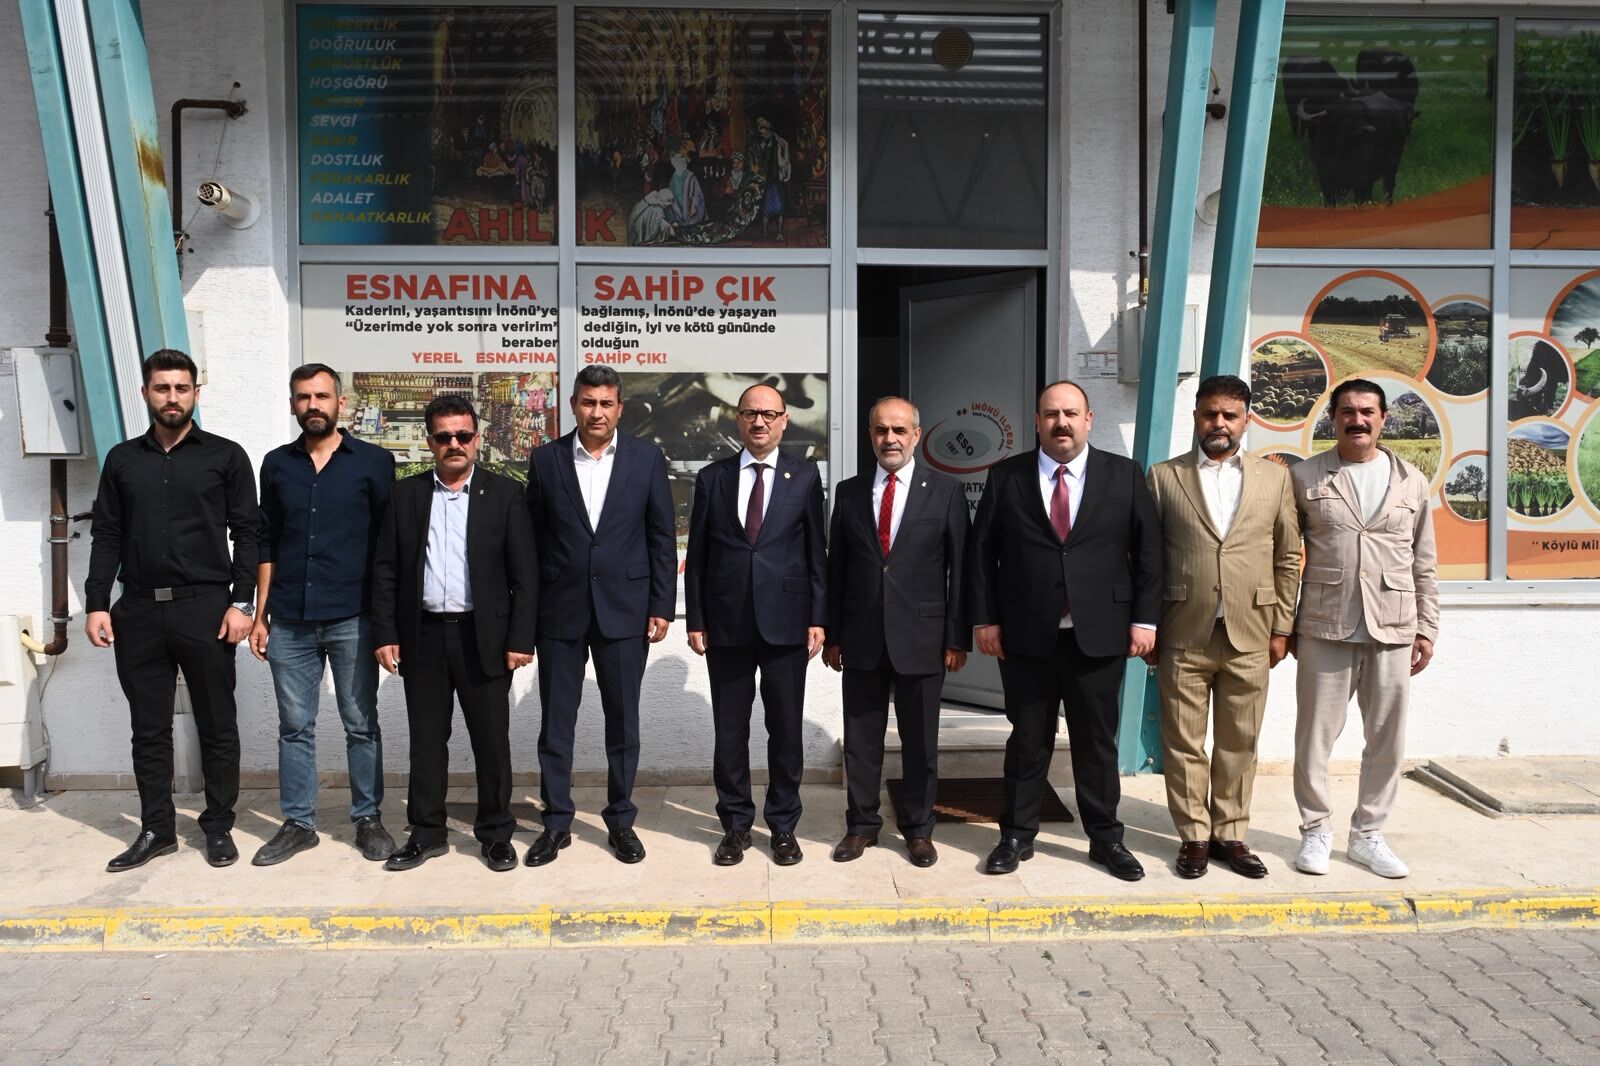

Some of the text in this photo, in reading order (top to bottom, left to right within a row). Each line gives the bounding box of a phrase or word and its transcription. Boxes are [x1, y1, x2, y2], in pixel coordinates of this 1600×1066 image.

[308, 17, 400, 32] RTLİK
[309, 36, 397, 50] DOĞRULUK
[308, 55, 402, 70] ÜTLÜK
[309, 75, 388, 91] HOŞGÖRÜ
[310, 113, 357, 128] SEVGİ
[310, 154, 384, 166] DOSTLUK
[311, 192, 374, 205] ADALET
[346, 270, 777, 306] ESNAFINA SAHİP ÇIK
[345, 304, 410, 318] Kaderini,
[415, 305, 492, 318] yaşantısını
[581, 305, 650, 319] bağlamış,
[719, 308, 777, 319] yaşayan
[427, 321, 453, 334] yok
[458, 323, 497, 332] sonra
[584, 322, 641, 334] dediğin,
[666, 324, 681, 333] ve
[684, 321, 715, 333] kötü
[718, 322, 776, 334] gününde
[502, 336, 639, 350] beraber olduğun
[412, 351, 668, 366] YEREL ESNAFINA SAHİP ÇIK!
[971, 402, 1000, 417] İNÖNÜ
[955, 432, 974, 456] ESO
[1581, 539, 1600, 550] Mil
